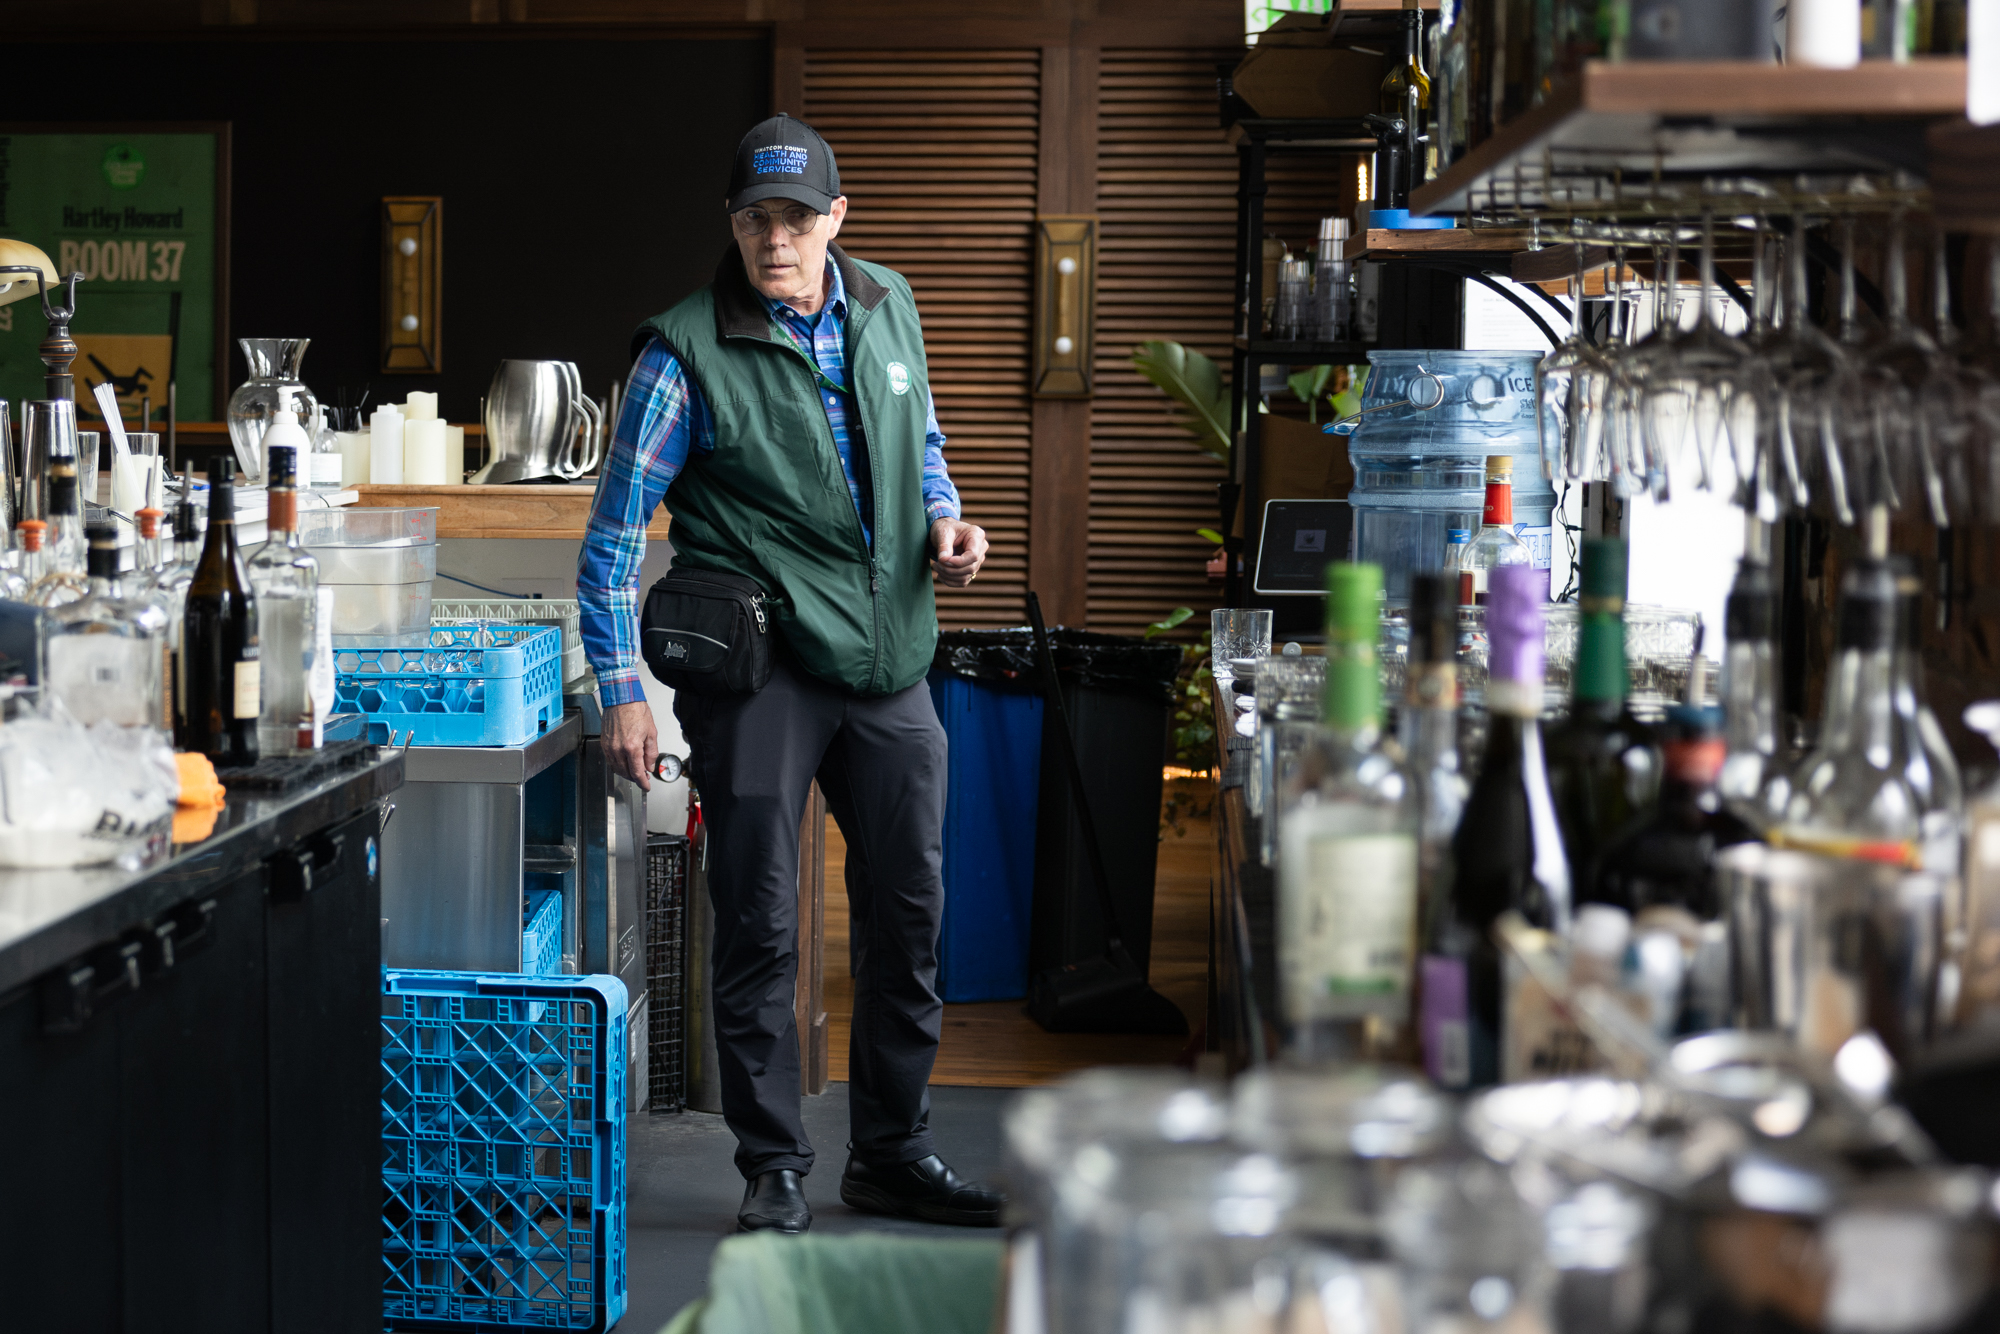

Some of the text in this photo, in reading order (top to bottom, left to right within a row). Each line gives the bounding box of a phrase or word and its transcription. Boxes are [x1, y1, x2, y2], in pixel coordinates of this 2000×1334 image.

[785, 145, 807, 153] COUNTY
[754, 150, 807, 160] HEALTH AND
[753, 158, 807, 167] COMMUNITY
[757, 166, 803, 174] SERVICES
[63, 206, 183, 231] Hartley Howard
[60, 240, 186, 281] ROOM 37
[1508, 377, 1534, 392] ICE
